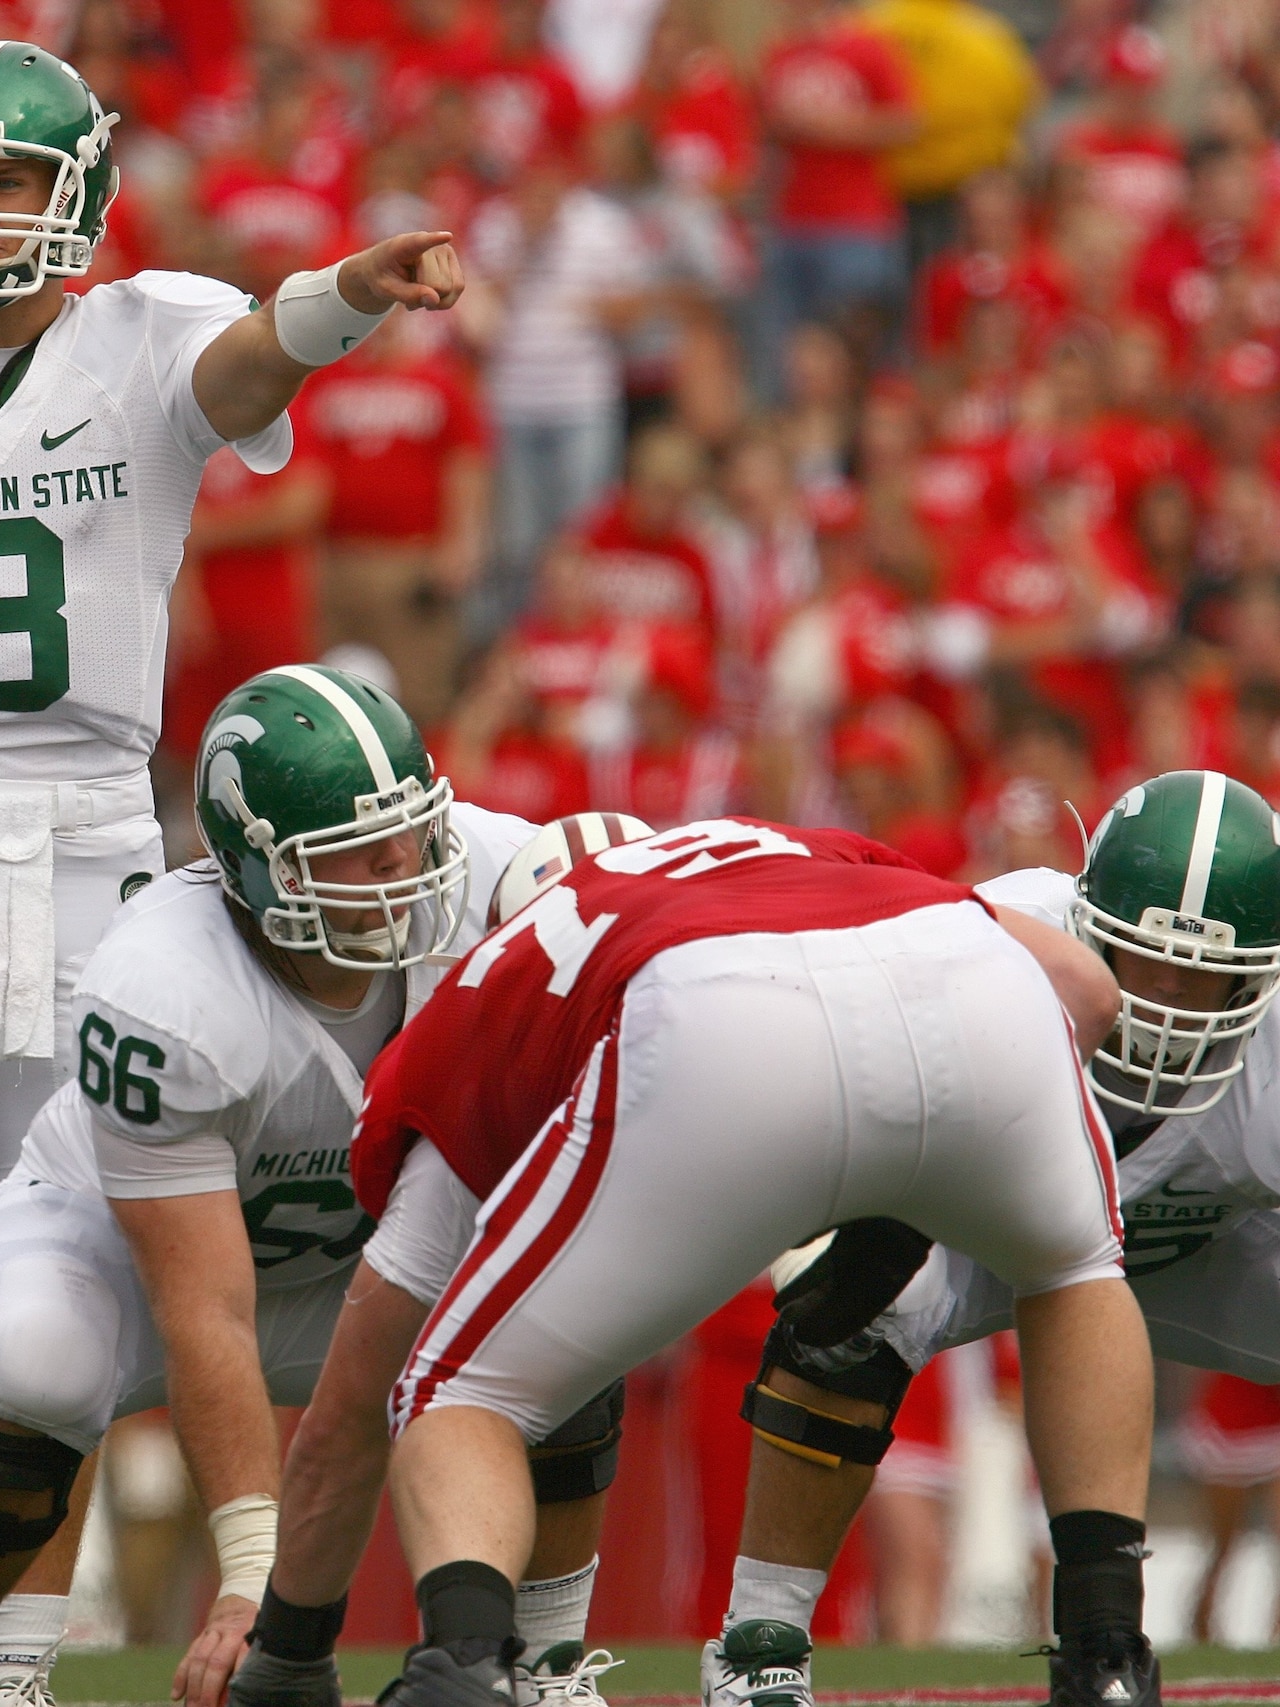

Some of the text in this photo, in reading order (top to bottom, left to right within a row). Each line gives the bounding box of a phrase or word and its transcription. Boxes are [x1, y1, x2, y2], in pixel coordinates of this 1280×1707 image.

[32, 461, 128, 508] STATE
[79, 1011, 166, 1126] 66
[1133, 1202, 1233, 1218] STATE
